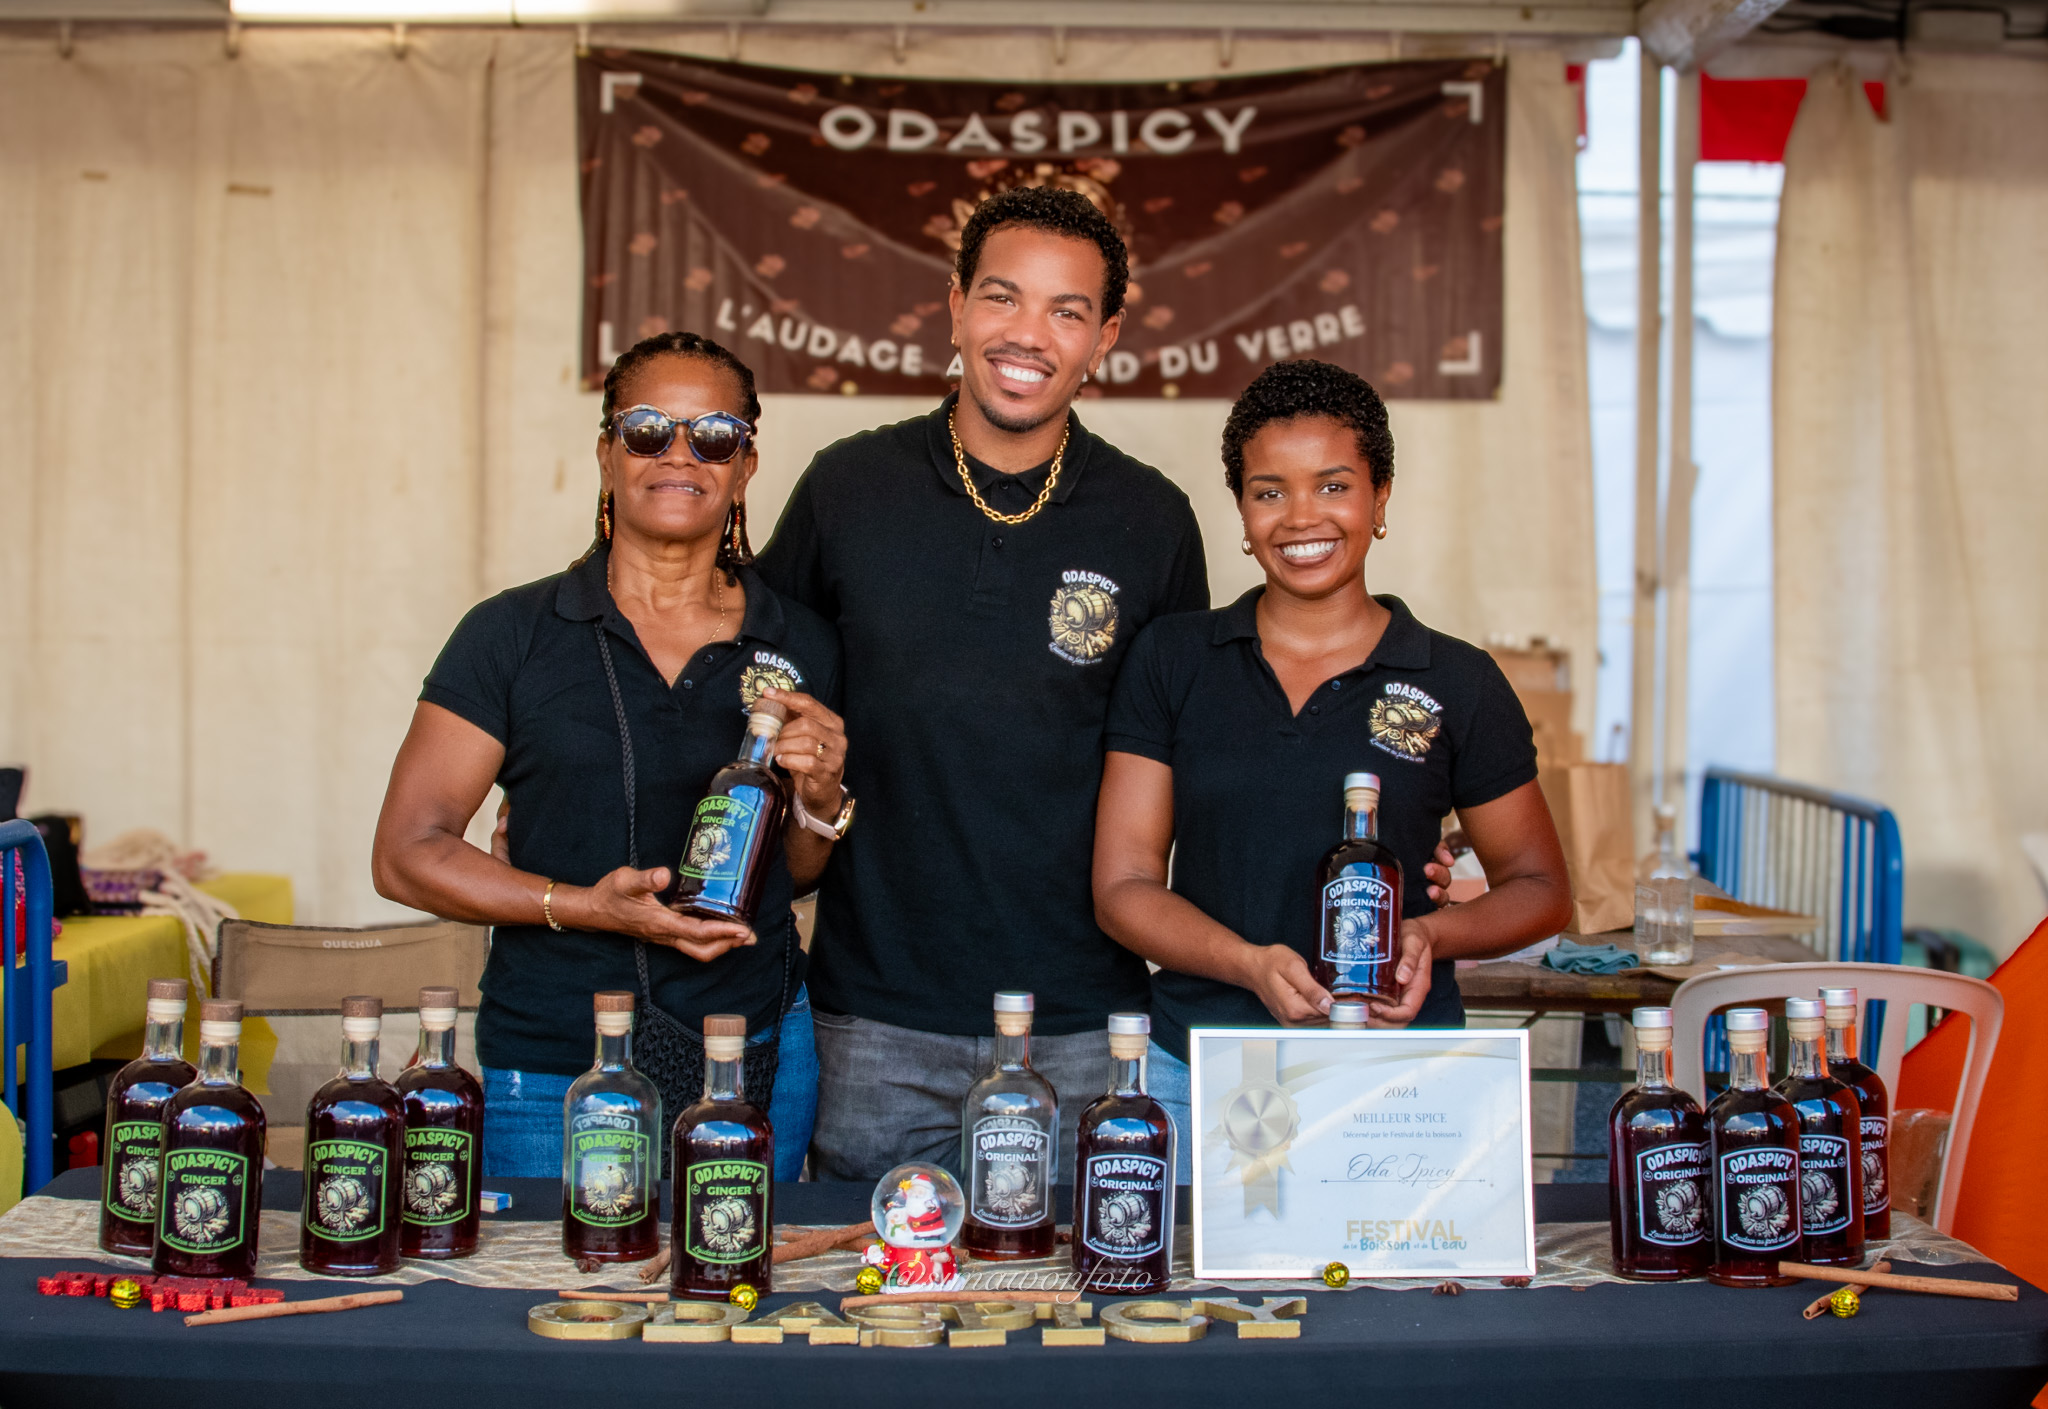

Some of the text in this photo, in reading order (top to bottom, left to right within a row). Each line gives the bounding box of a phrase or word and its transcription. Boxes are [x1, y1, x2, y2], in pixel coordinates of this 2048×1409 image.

[819, 104, 1258, 155] ODASPICY
[716, 298, 922, 376] L'AUDACE
[945, 352, 965, 378] A
[1160, 340, 1218, 379] DU
[1235, 304, 1366, 363] VERRE
[1062, 570, 1120, 595] ODASPICY
[754, 651, 802, 684] ODASPICY
[1385, 683, 1443, 714] ODASPICY
[698, 799, 749, 819] ODASPICY
[701, 815, 736, 827] GINGER
[1329, 880, 1387, 899] ODASPICY
[1333, 898, 1382, 908] ORIGINAL
[322, 939, 382, 949] QUECHUA
[1383, 1086, 1419, 1099] 2024
[1353, 1112, 1448, 1124] MEILLEUR SPICE
[1342, 1131, 1369, 1139] Décerné
[1370, 1132, 1381, 1140] par
[1860, 1121, 1887, 1137] SPICY
[406, 1131, 465, 1150] DASPICY
[578, 1134, 642, 1152] ODASPICY
[980, 1132, 1043, 1151] ODASPICY
[1800, 1139, 1842, 1157] SPICY
[126, 1145, 160, 1157] GINGE
[314, 1144, 380, 1165] ODASPICY
[411, 1151, 455, 1162] GINGER
[589, 1154, 632, 1163] GINGER
[985, 1152, 1038, 1162] ORIGINAL
[171, 1153, 240, 1174] ODASPICY
[322, 1164, 367, 1176] GINGER
[1094, 1159, 1161, 1179] ODASPICY
[1347, 1153, 1456, 1190] Oda Spicy
[1729, 1152, 1793, 1174] ODASPICY
[1801, 1159, 1838, 1169] GINAL
[180, 1174, 227, 1185] GINGER
[694, 1164, 761, 1184] ODASPICY
[1736, 1173, 1789, 1185] ORIGINAL
[706, 1186, 752, 1196] GINGER
[1099, 1179, 1154, 1191] ORIGINAL
[1346, 1219, 1463, 1241] FESTIVAL
[1360, 1236, 1410, 1251] Boisson
[1431, 1237, 1467, 1251] L'eau
[527, 1294, 1307, 1347] ODASPICY
